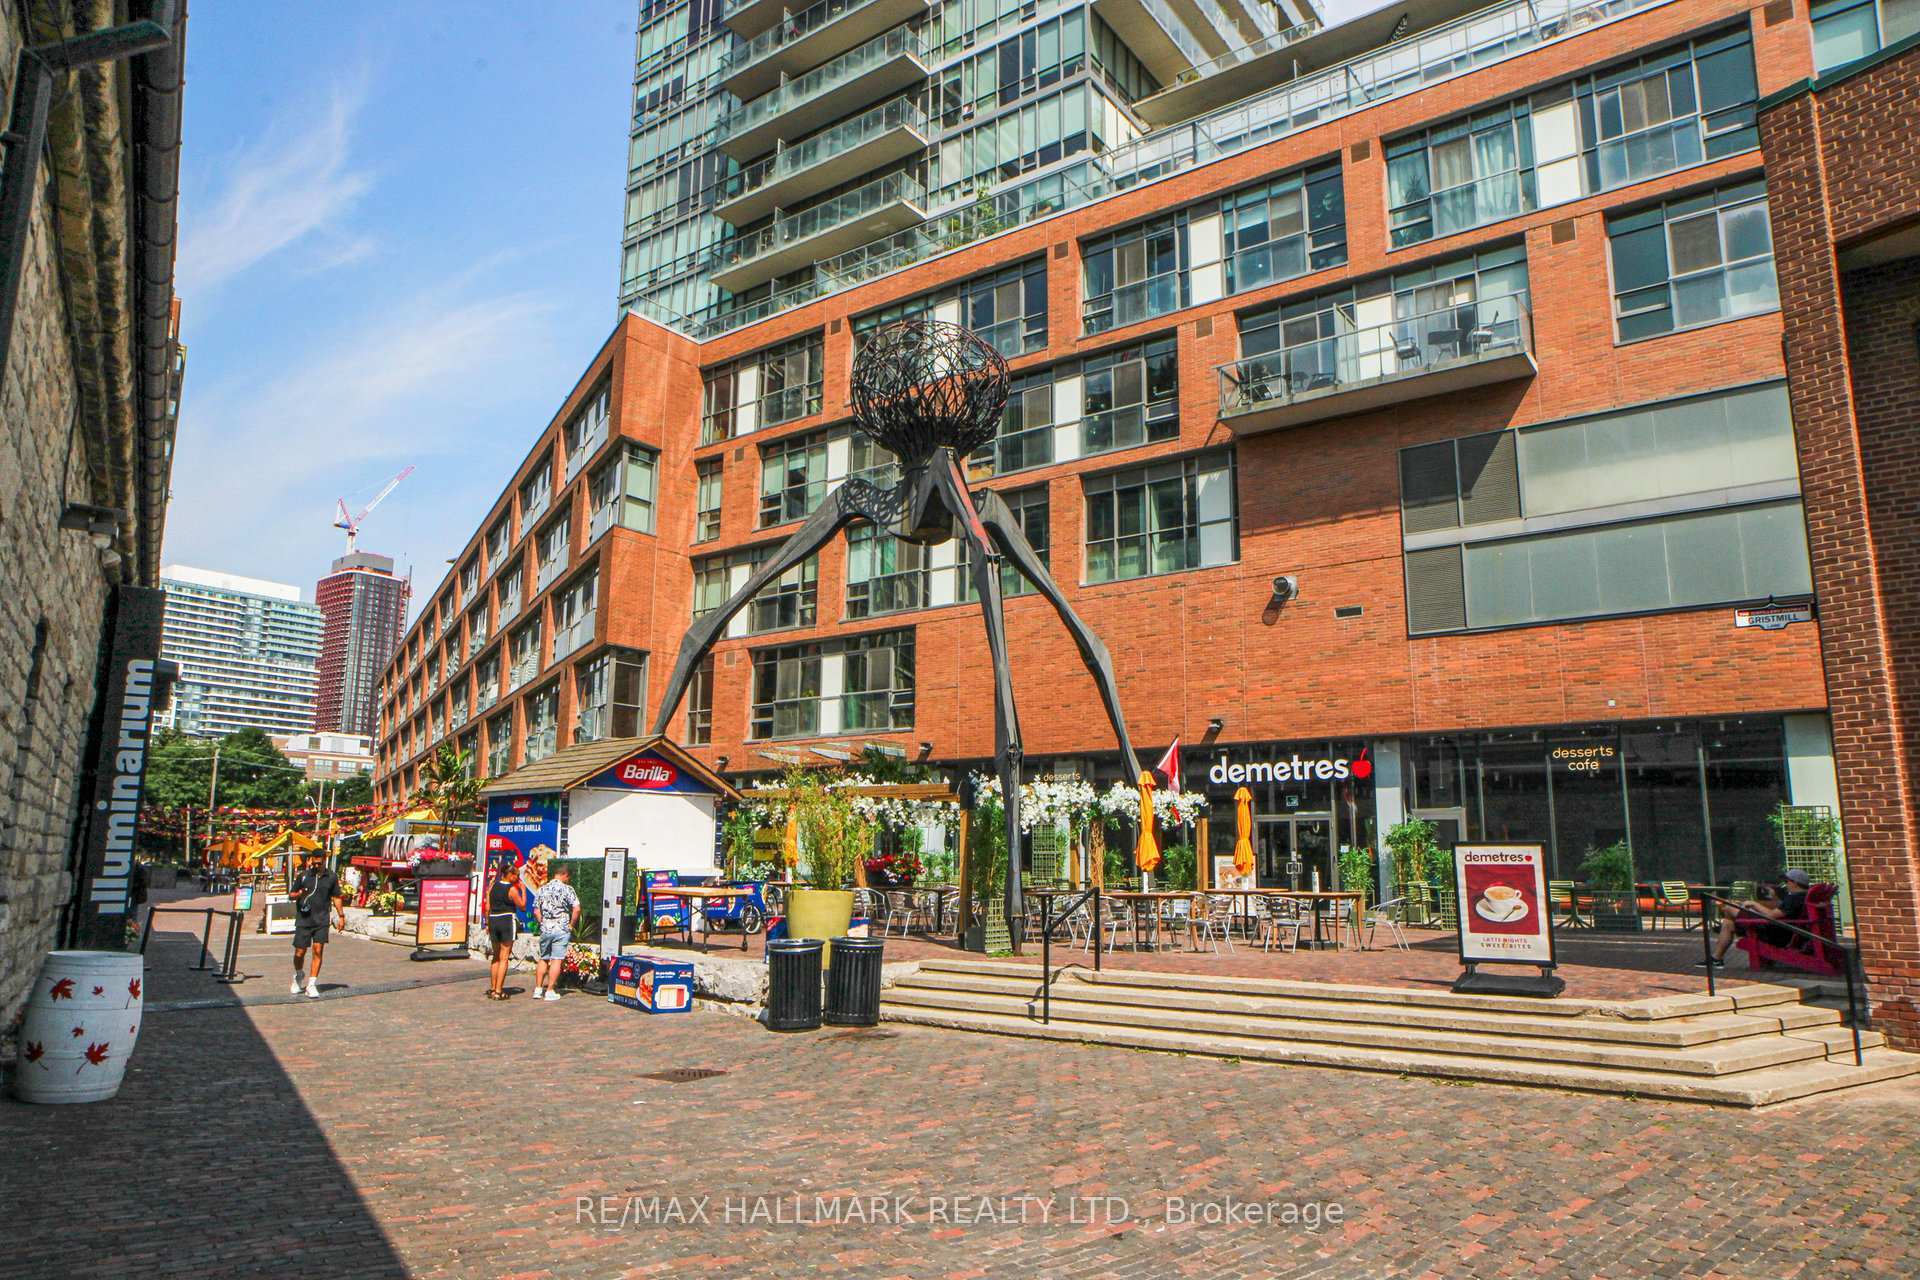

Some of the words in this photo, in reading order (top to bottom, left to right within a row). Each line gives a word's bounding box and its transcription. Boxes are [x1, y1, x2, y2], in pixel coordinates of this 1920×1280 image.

[1748, 613, 1798, 625] GRISTMILL
[1552, 745, 1615, 759] desserts
[1209, 754, 1350, 784] demetres
[1567, 758, 1600, 771] cafe
[623, 764, 670, 781] Barilla
[91, 659, 154, 913] illuminarium
[1464, 852, 1524, 863] demetres
